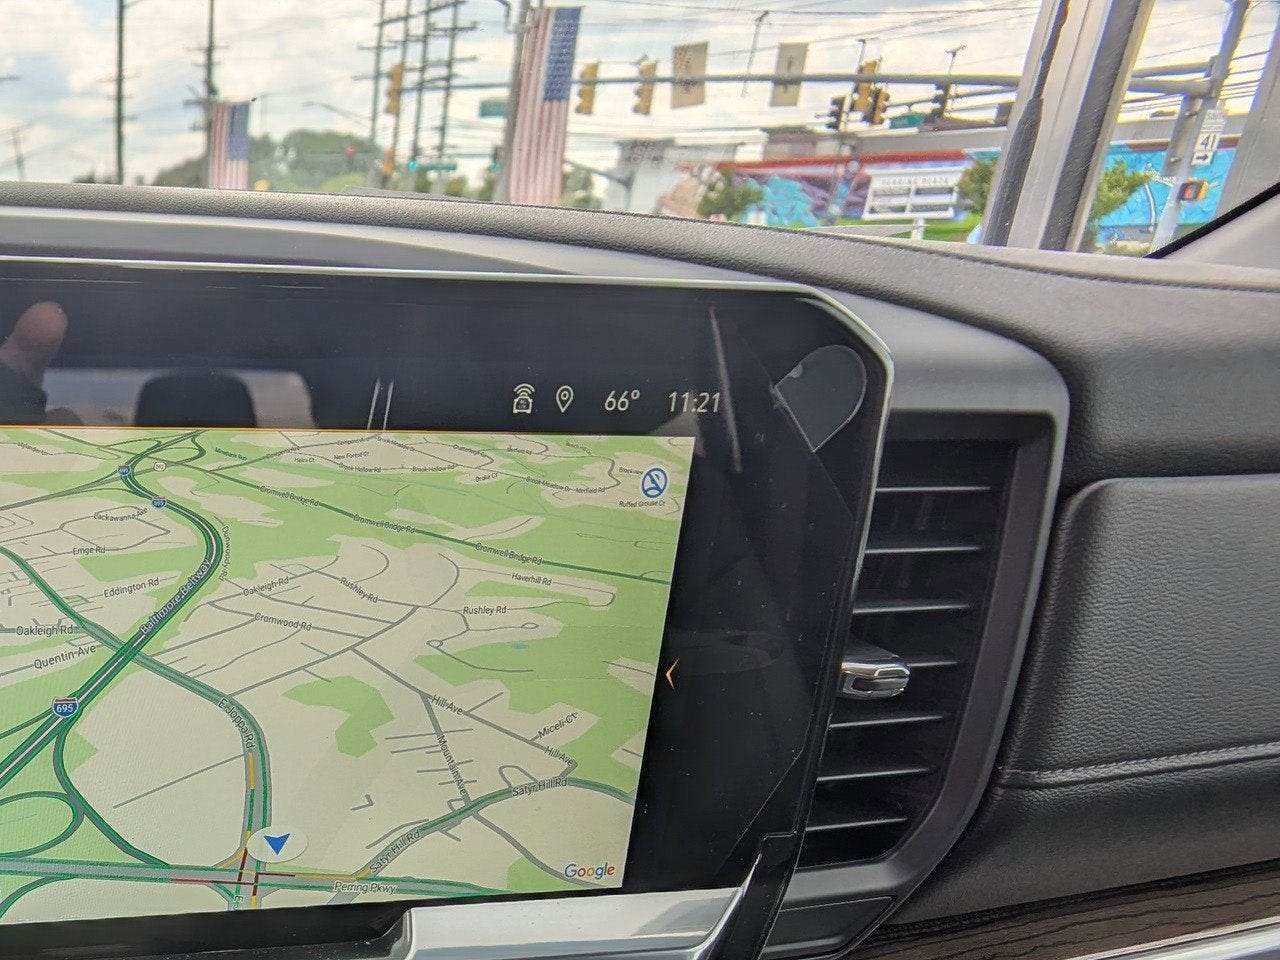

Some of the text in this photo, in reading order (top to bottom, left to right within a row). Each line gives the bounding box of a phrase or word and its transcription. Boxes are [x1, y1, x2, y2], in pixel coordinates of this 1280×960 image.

[1199, 134, 1217, 149] 41
[604, 389, 640, 411] 66°
[669, 392, 720, 413] 11:21
[95, 545, 106, 555] Rd
[475, 541, 507, 559] Cromwell
[103, 577, 160, 599] Eddington Rd
[243, 576, 289, 597] Oakleigh Rd
[512, 572, 552, 586] Haverhill Rd
[140, 558, 212, 636] Baltimore Beltway
[340, 577, 379, 604] Rushley Rd
[463, 604, 507, 616] Rushley Rd
[16, 625, 74, 637] Oakleigh Rd
[253, 612, 312, 632] Cromwood Rd
[33, 645, 97, 669] Quentin Ave
[56, 703, 74, 713] 695
[431, 694, 464, 716] Hill Ave
[217, 698, 256, 749] E Joppa Rd
[538, 712, 578, 739] Miceli Ct
[437, 735, 469, 796] Mountain Ave
[544, 745, 574, 766] Hill Ave
[512, 776, 568, 798] Satyr Hill Rd
[369, 828, 421, 873] Satyr Hill Rd
[563, 862, 616, 881] Google
[334, 881, 397, 895] Perring Pkwy
